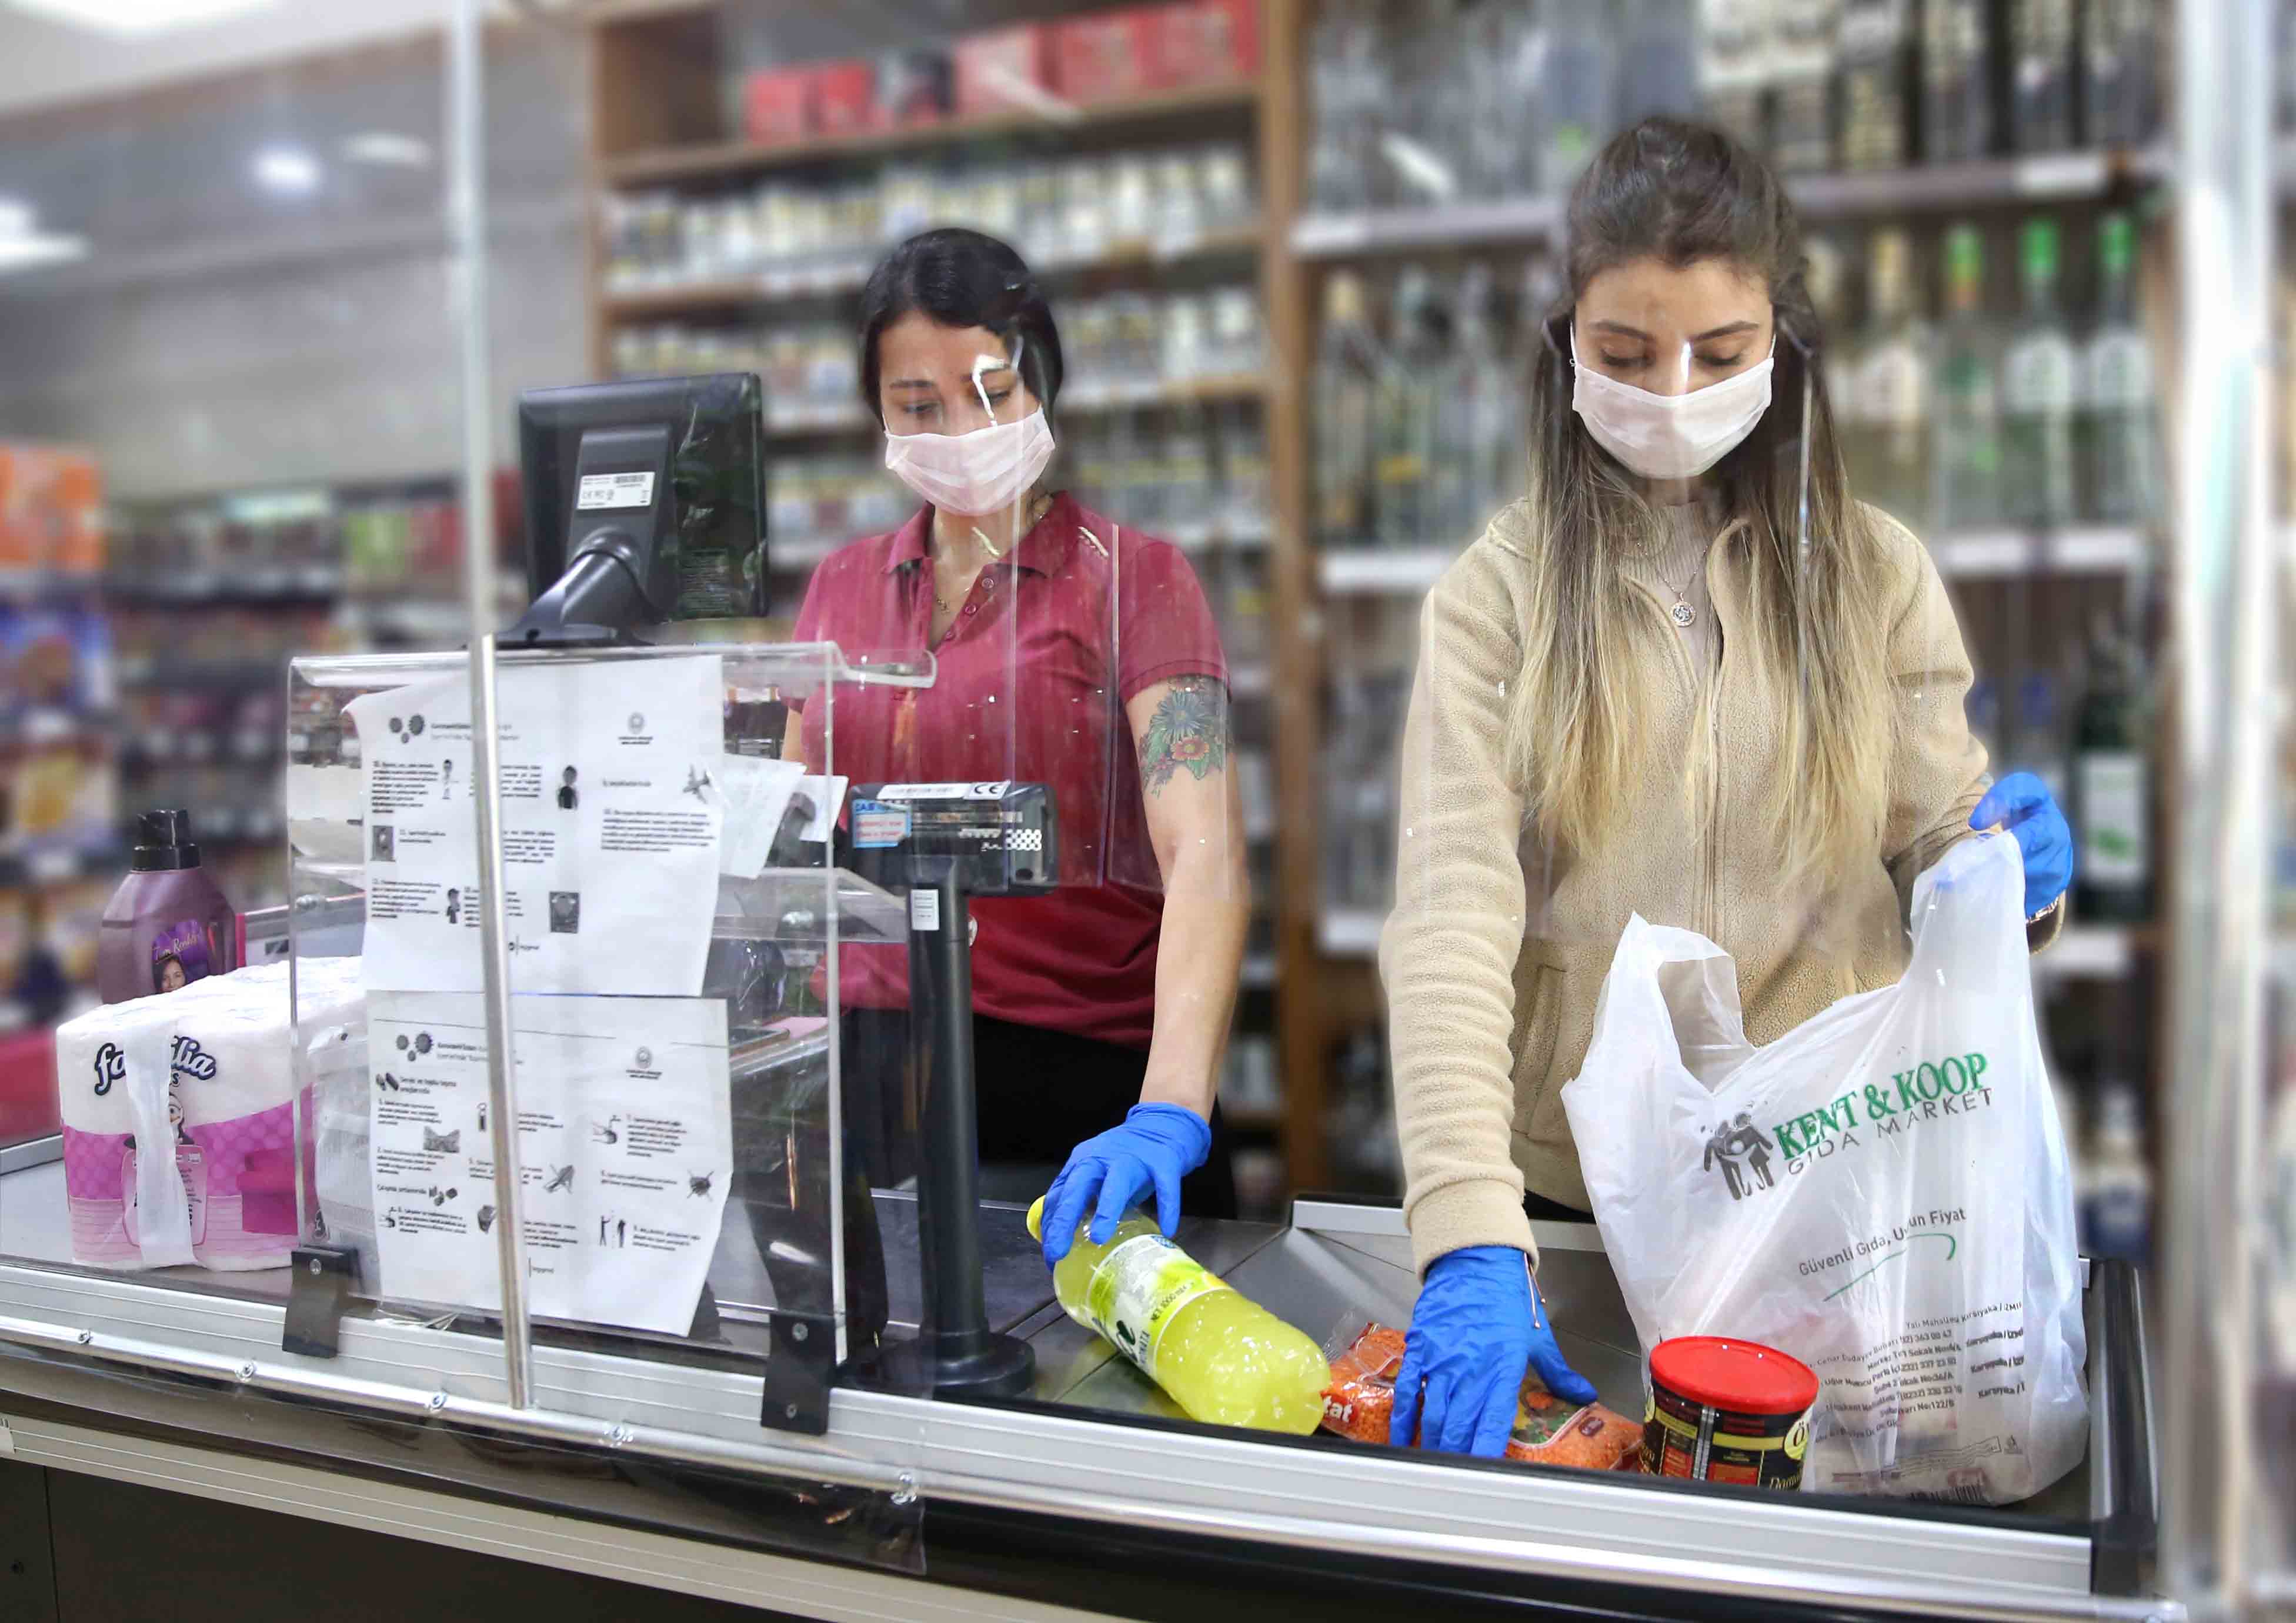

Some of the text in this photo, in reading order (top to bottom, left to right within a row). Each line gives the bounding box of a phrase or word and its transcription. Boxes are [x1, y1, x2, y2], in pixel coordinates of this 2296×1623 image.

[94, 1035, 216, 1096] failia
[1773, 1053, 1988, 1160] KENT & KOOP
[1788, 1087, 1993, 1175] GIDA MARKET
[1798, 1208, 1967, 1277] Güvenli Gıda, Uun Fiyat
